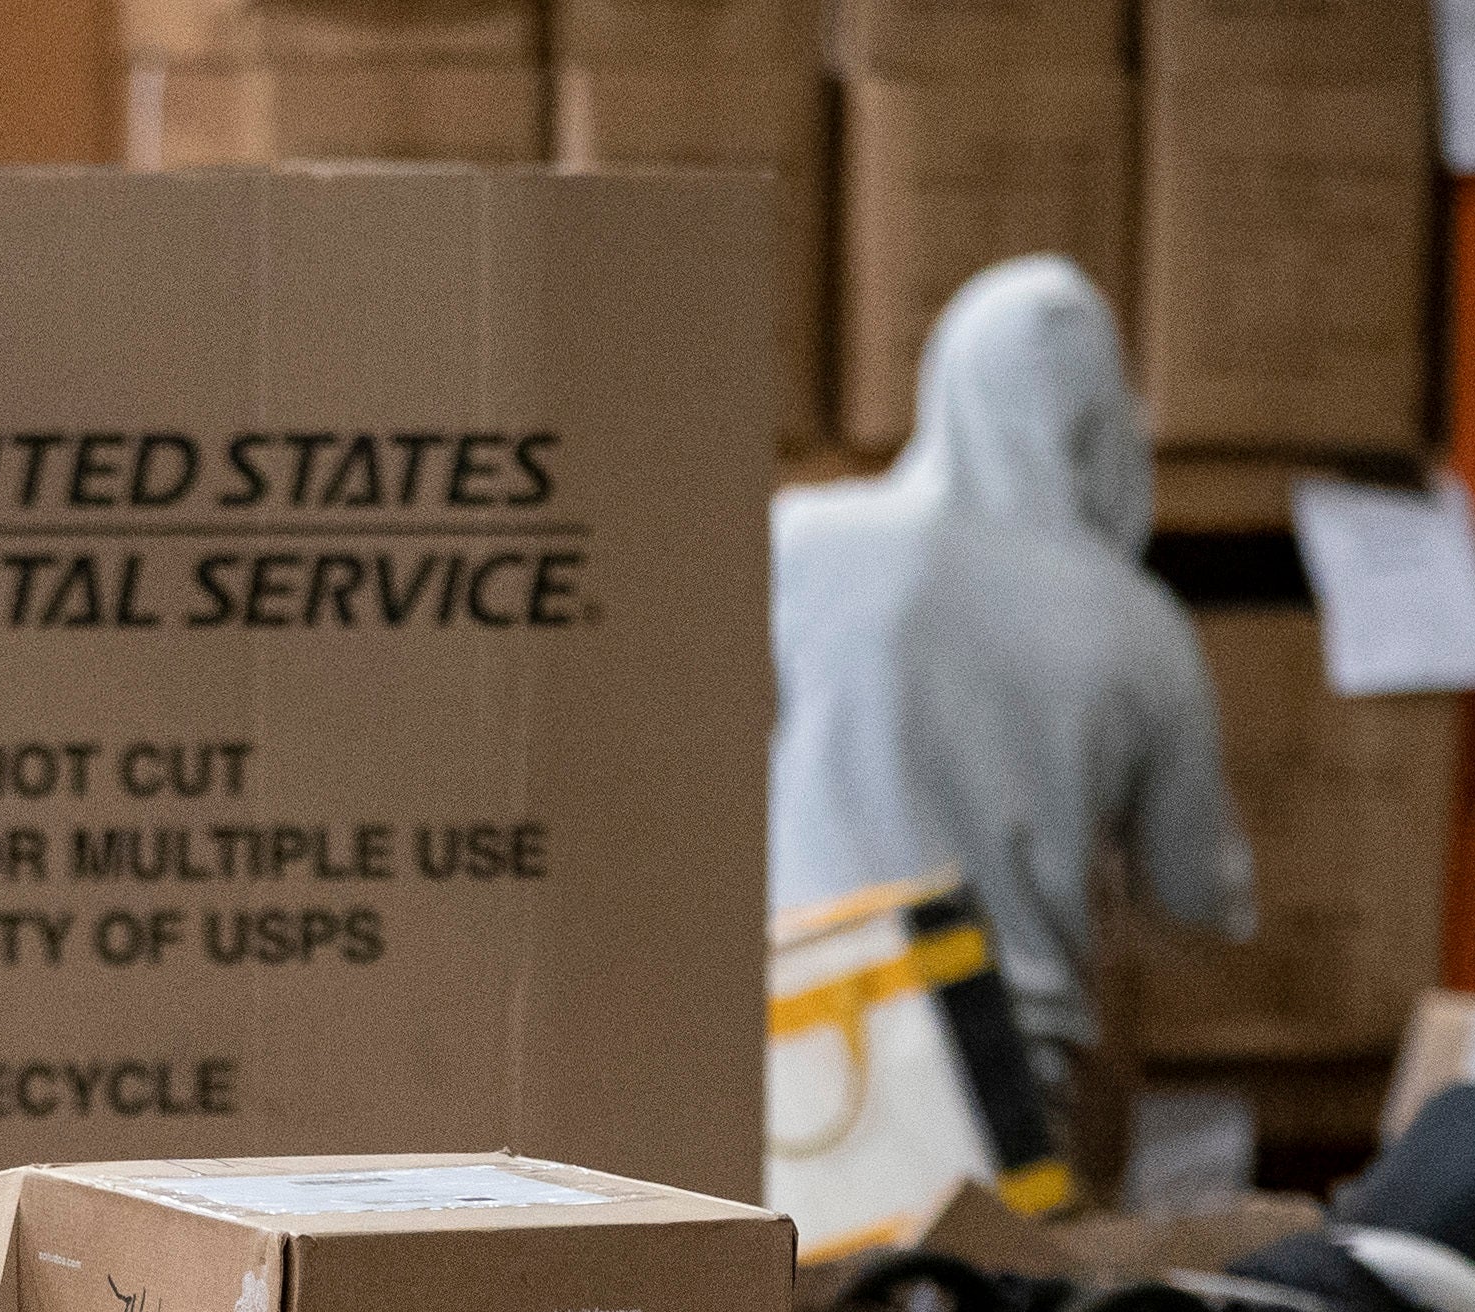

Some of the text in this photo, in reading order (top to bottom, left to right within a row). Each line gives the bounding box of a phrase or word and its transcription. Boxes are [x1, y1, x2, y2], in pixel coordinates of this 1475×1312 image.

[217, 431, 562, 509] STATES
[116, 741, 255, 800] CUT
[69, 823, 394, 882] MULTIPLE
[414, 822, 549, 880] USE
[94, 908, 185, 967] OF
[203, 906, 386, 966] USPS
